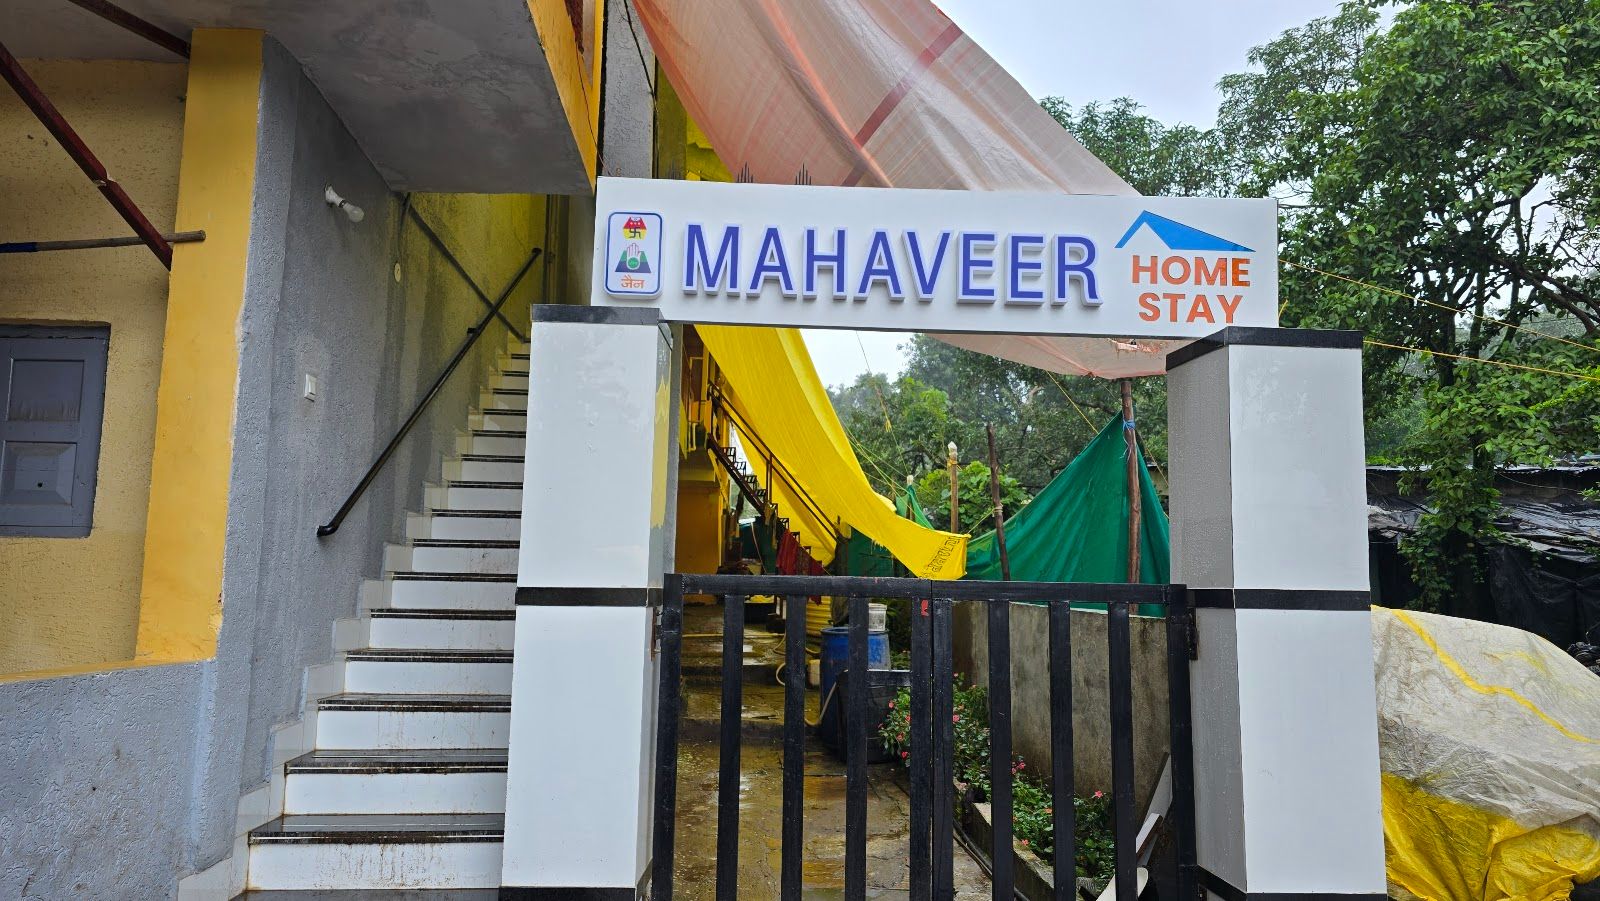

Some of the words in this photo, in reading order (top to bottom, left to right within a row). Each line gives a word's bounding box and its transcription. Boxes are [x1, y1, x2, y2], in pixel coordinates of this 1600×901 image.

[685, 223, 1100, 301] MAHAVEER
[1132, 255, 1251, 287] HOME
[620, 274, 645, 289] जैन
[1138, 292, 1243, 324] STAY
